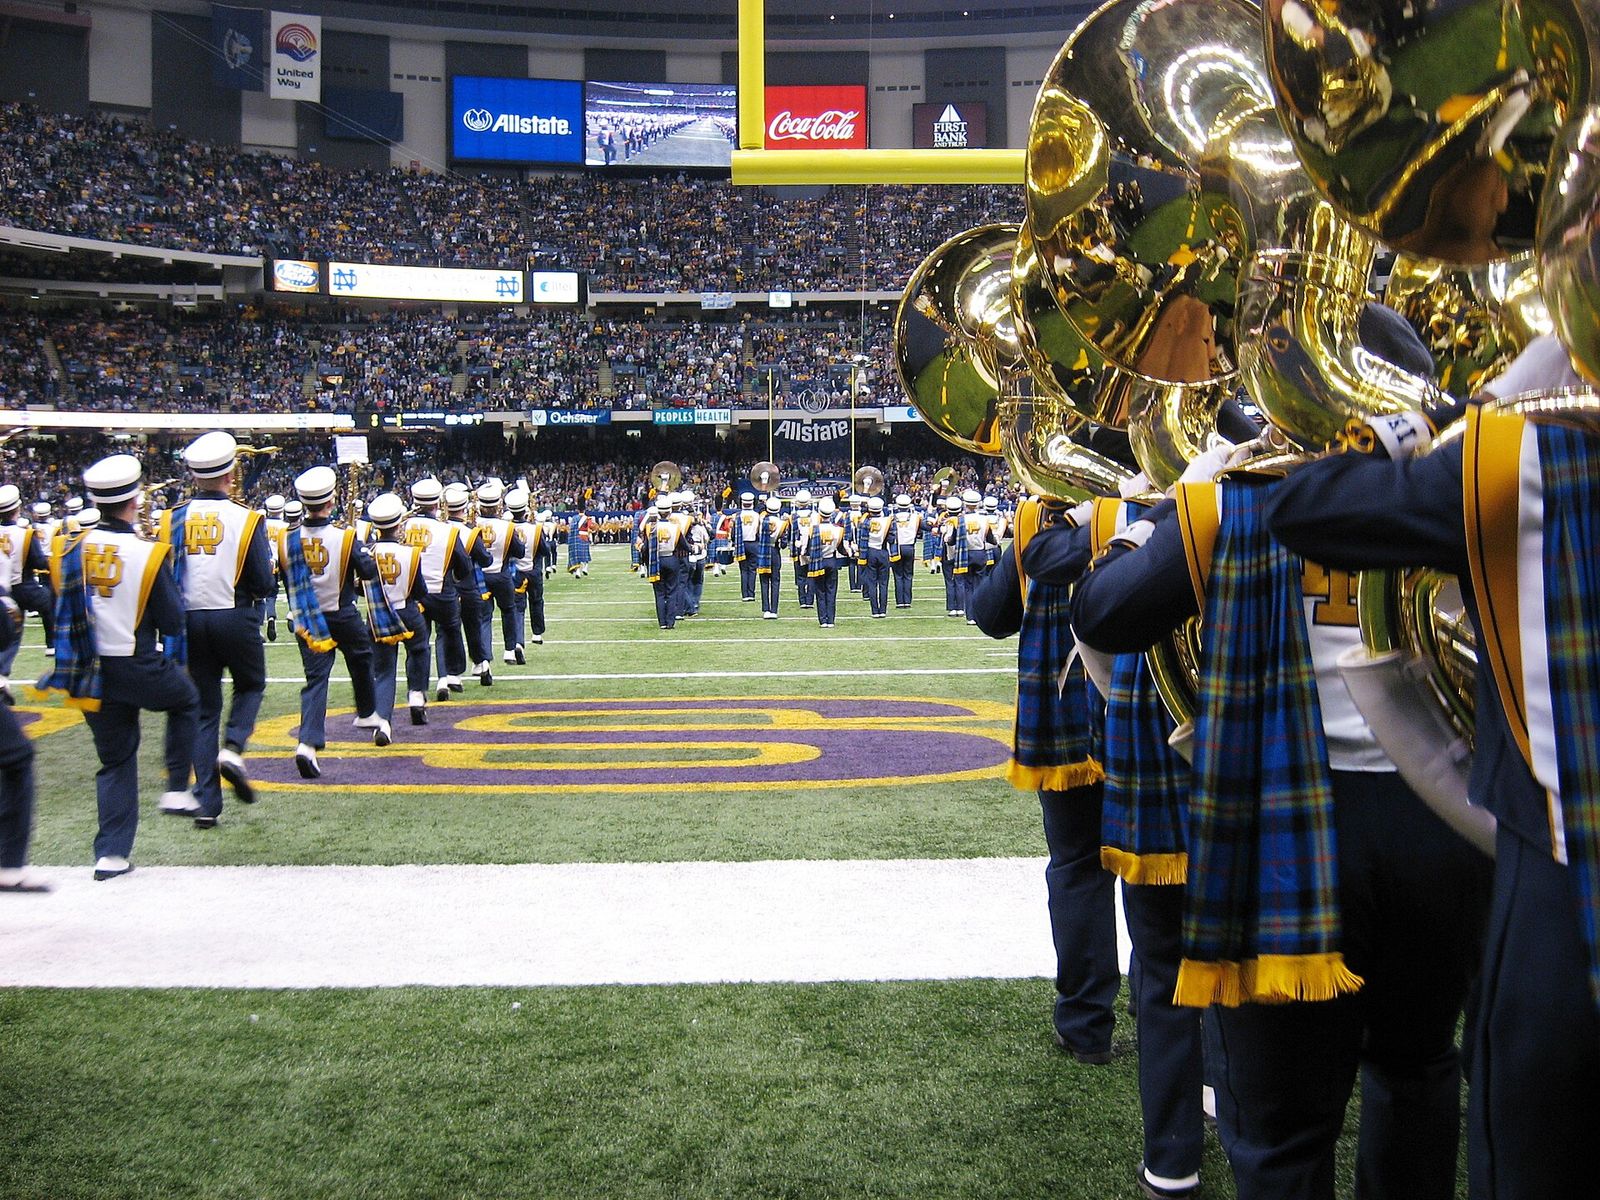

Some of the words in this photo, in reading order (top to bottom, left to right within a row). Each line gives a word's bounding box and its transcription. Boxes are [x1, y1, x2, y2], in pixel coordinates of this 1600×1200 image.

[277, 68, 314, 79] United
[277, 78, 301, 89] Way
[768, 110, 860, 142] Coca-Cola
[933, 121, 968, 132] FIRST
[933, 132, 968, 142] BANK
[550, 411, 598, 423] Ochsner
[655, 411, 693, 422] PEOPLES
[696, 410, 729, 422] HEALTH
